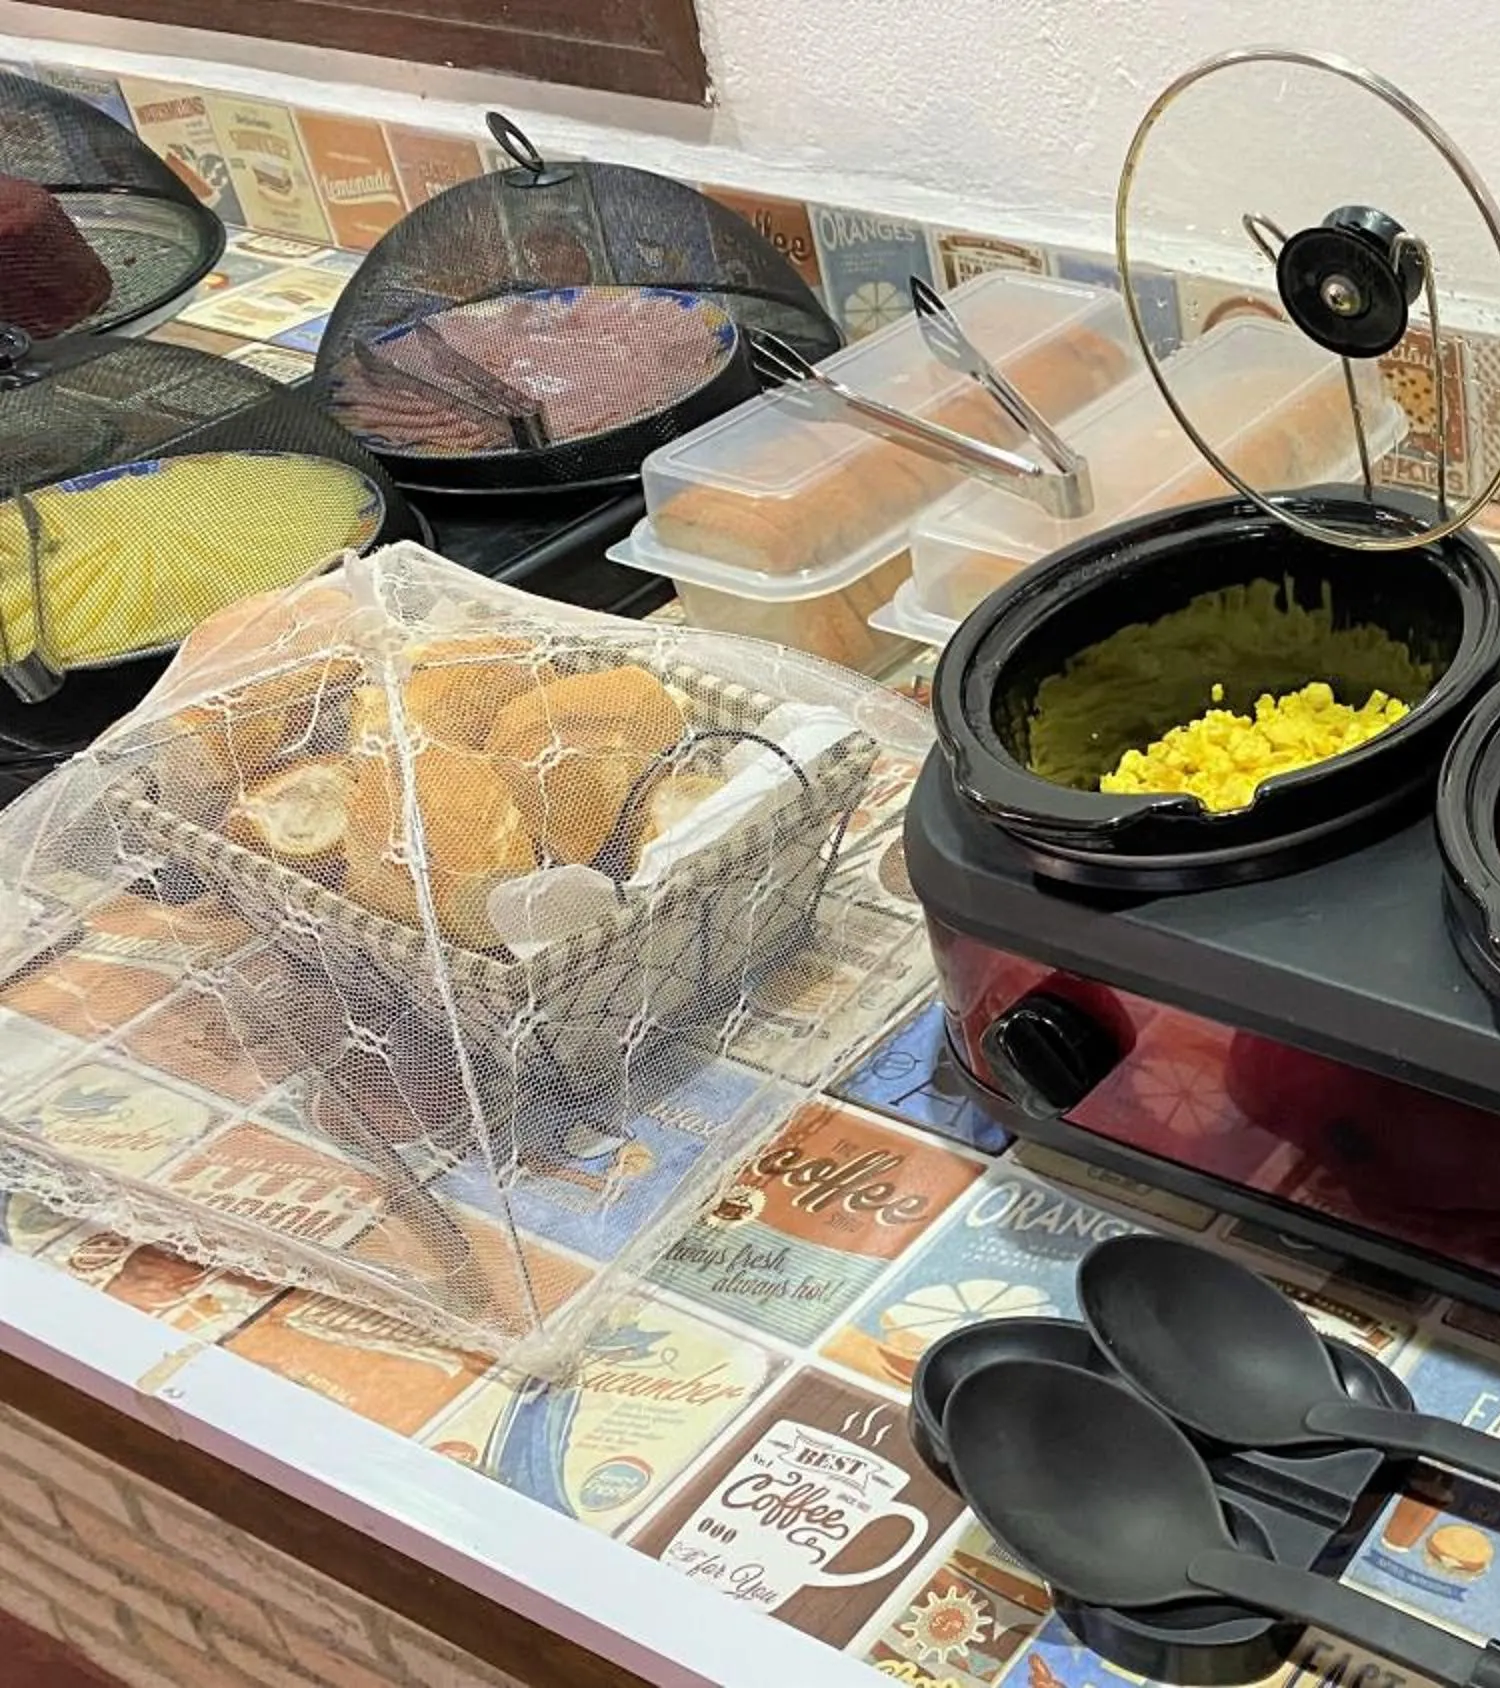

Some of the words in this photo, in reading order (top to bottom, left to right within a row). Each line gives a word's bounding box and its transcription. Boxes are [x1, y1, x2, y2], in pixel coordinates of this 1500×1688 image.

[818, 206, 917, 250] ORANGES
[756, 1146, 929, 1226] coffee
[966, 1182, 1150, 1242] ORANG
[580, 1360, 746, 1406] ucumber
[796, 1447, 868, 1475] BEST
[721, 1471, 849, 1541] Coffee
[686, 1554, 726, 1579] for
[724, 1563, 779, 1605] You
